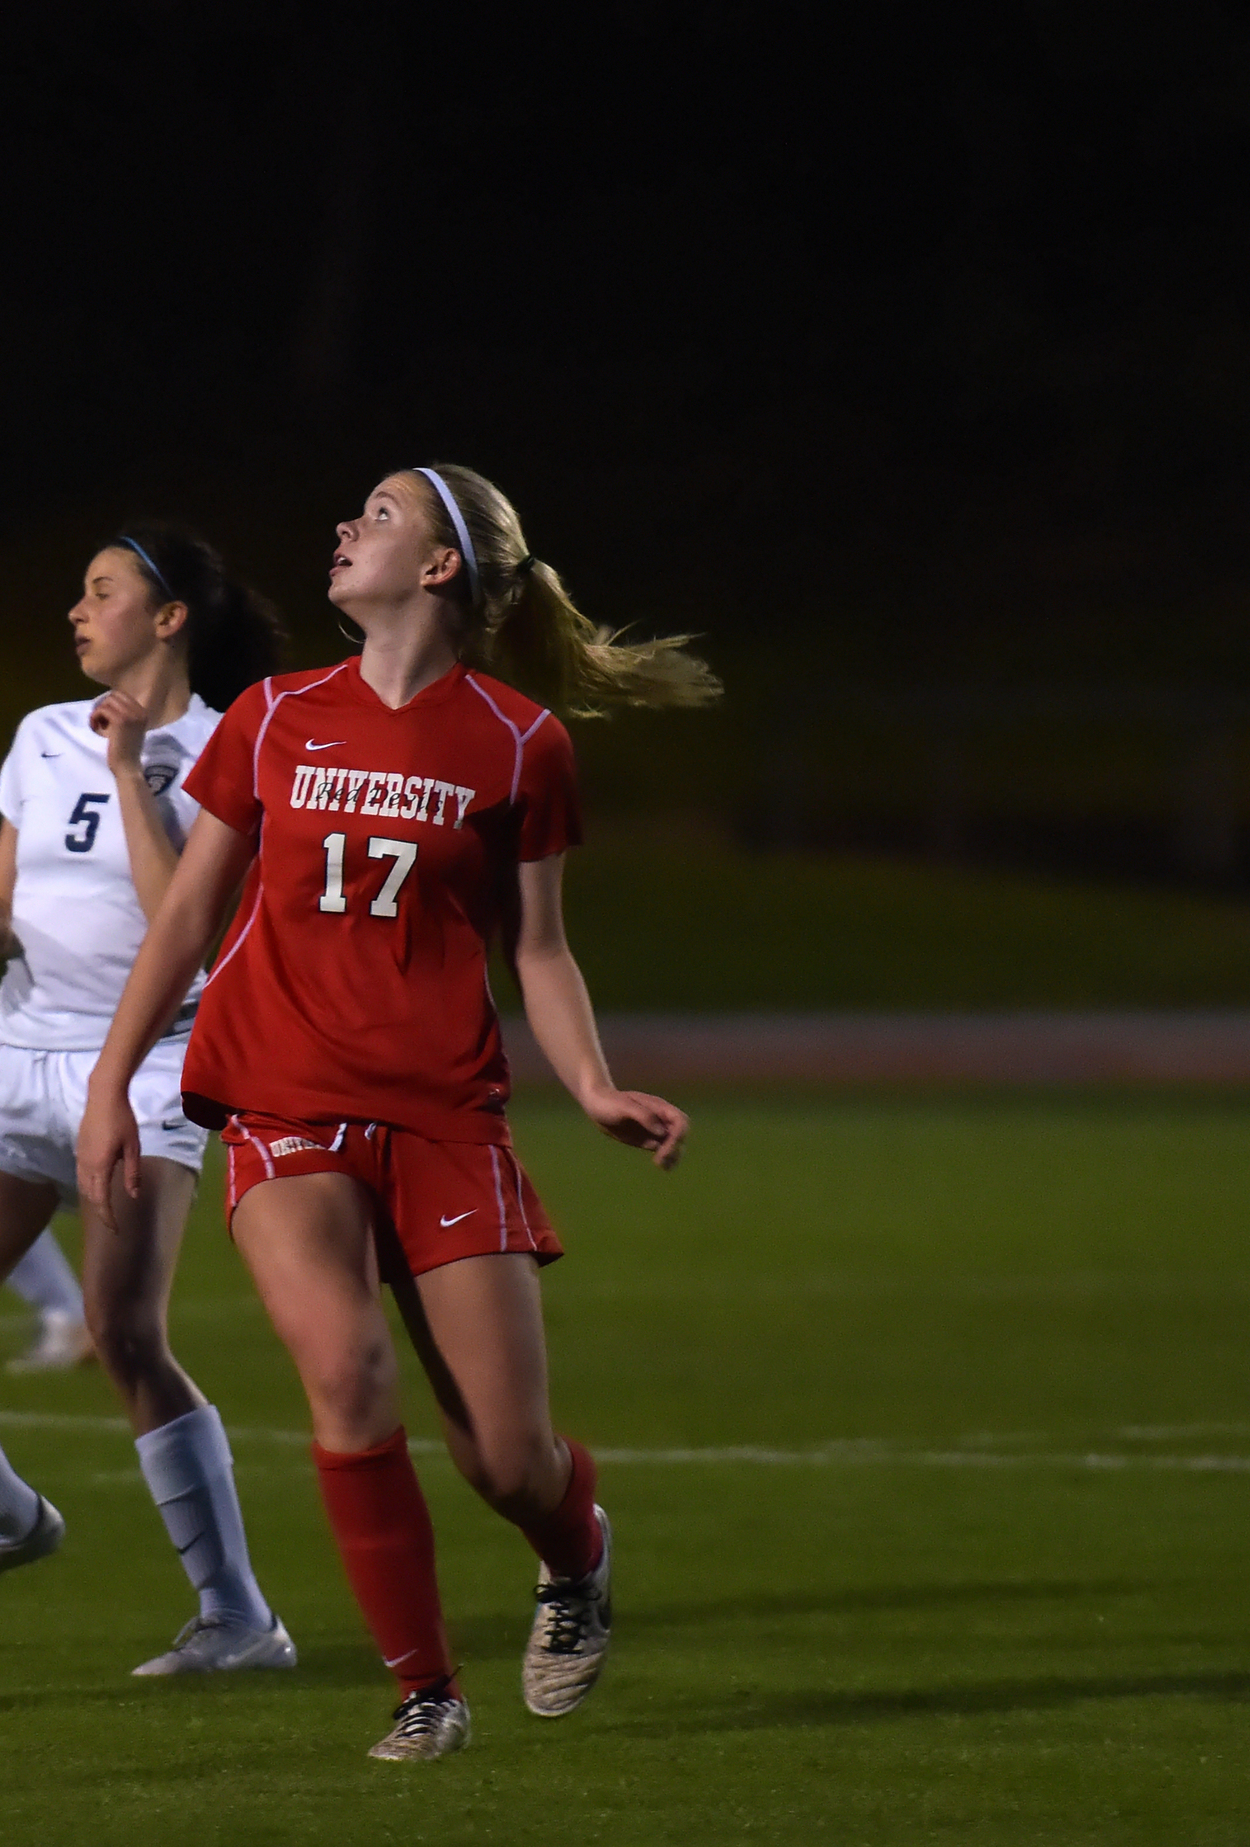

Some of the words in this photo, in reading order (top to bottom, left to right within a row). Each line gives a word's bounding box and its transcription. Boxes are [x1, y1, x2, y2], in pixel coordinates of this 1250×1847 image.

[65, 793, 111, 852] 5
[289, 765, 476, 830] UNIVERSITY
[316, 781, 369, 803] Red
[318, 831, 419, 918] 17
